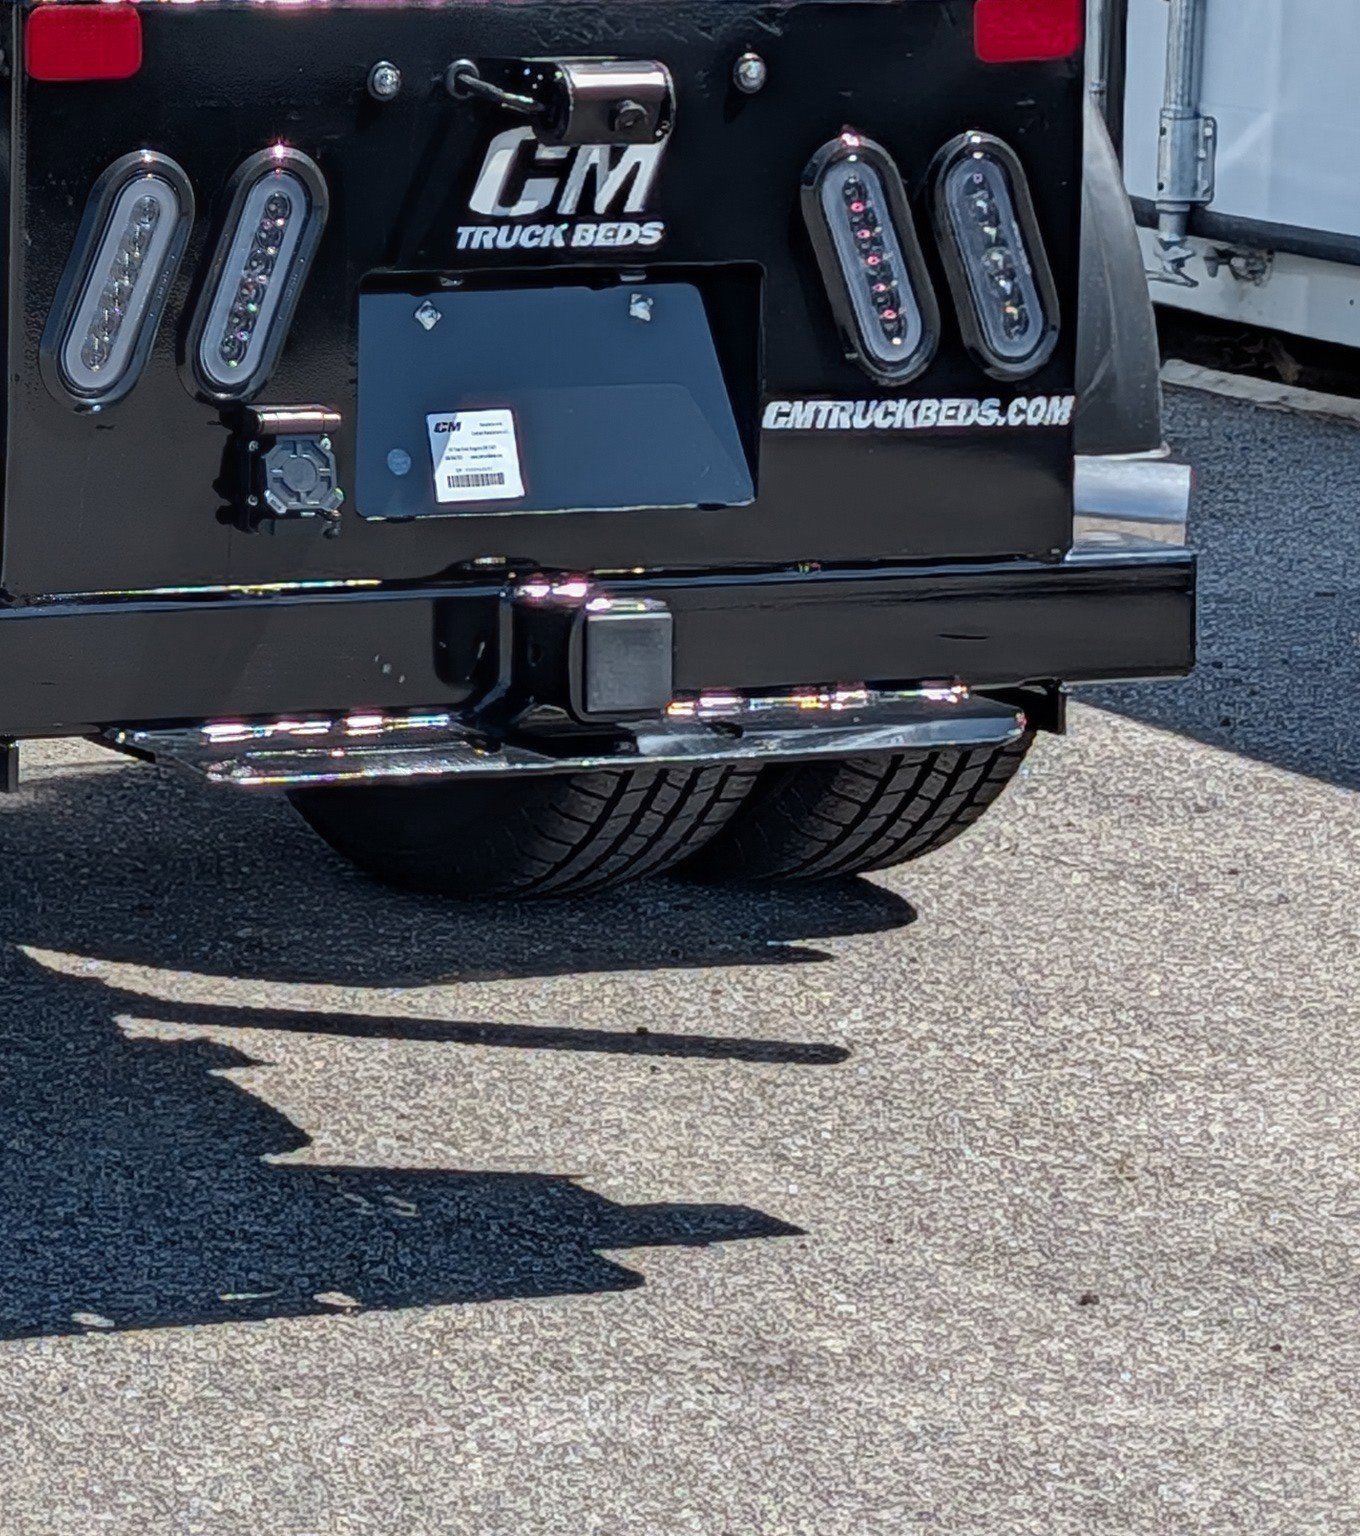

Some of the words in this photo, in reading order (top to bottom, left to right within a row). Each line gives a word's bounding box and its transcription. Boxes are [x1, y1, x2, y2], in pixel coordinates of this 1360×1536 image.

[468, 125, 666, 217] CM
[456, 222, 569, 250] TRUCK
[570, 220, 666, 248] BEDS
[433, 421, 463, 434] CM
[761, 394, 1077, 430] CMTRUCKBEDS.COM
